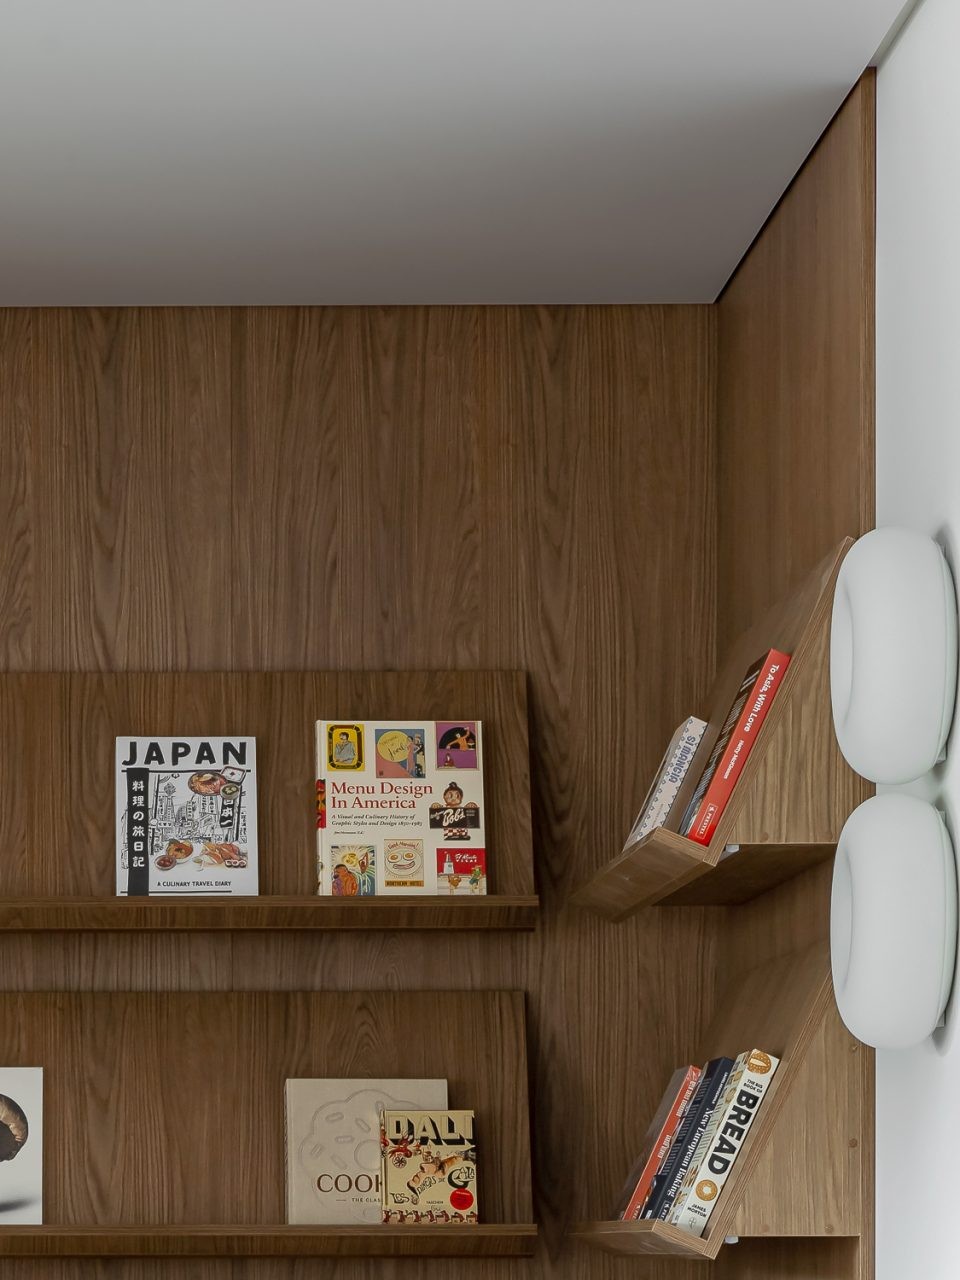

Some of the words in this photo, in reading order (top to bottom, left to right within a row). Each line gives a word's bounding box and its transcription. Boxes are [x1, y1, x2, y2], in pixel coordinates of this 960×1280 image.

[770, 664, 780, 674] To
[760, 673, 774, 693] Asia,
[752, 693, 767, 713] With
[744, 712, 758, 732] Love
[121, 741, 247, 766] JAPAN
[331, 782, 375, 794] Menu
[380, 781, 433, 798] Design
[331, 797, 347, 809] In
[349, 796, 416, 809] America
[132, 780, 145, 868] 料理の旅日記
[700, 1107, 713, 1127] New
[708, 1089, 759, 1176] BREAD
[681, 1126, 705, 1167] European
[667, 1164, 688, 1198] Baking
